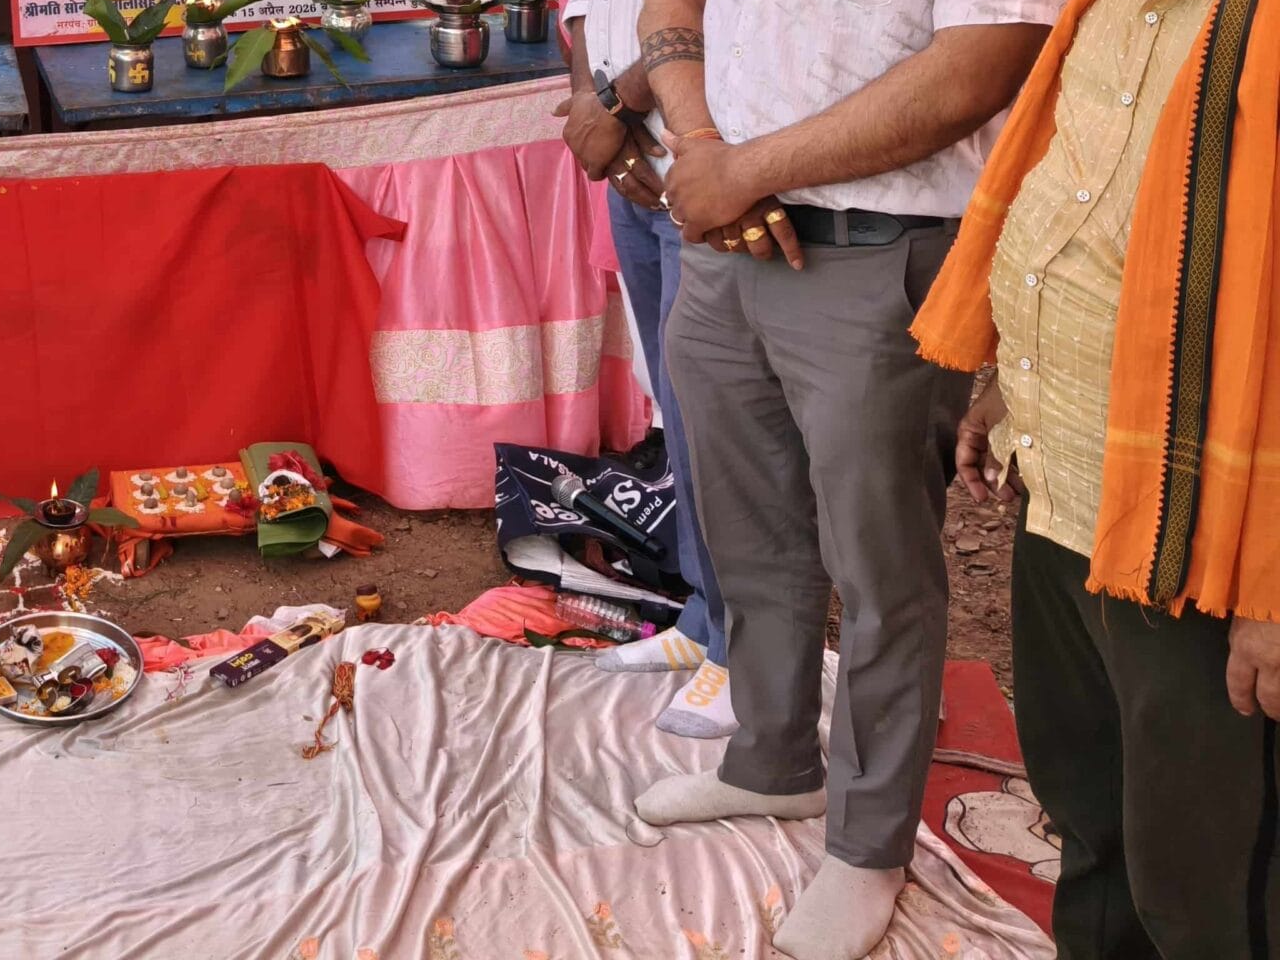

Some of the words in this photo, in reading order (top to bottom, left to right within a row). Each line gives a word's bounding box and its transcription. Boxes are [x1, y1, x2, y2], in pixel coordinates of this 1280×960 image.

[242, 8, 255, 17] 15
[259, 2, 284, 15] अप्रैल
[289, 4, 317, 14] 2026
